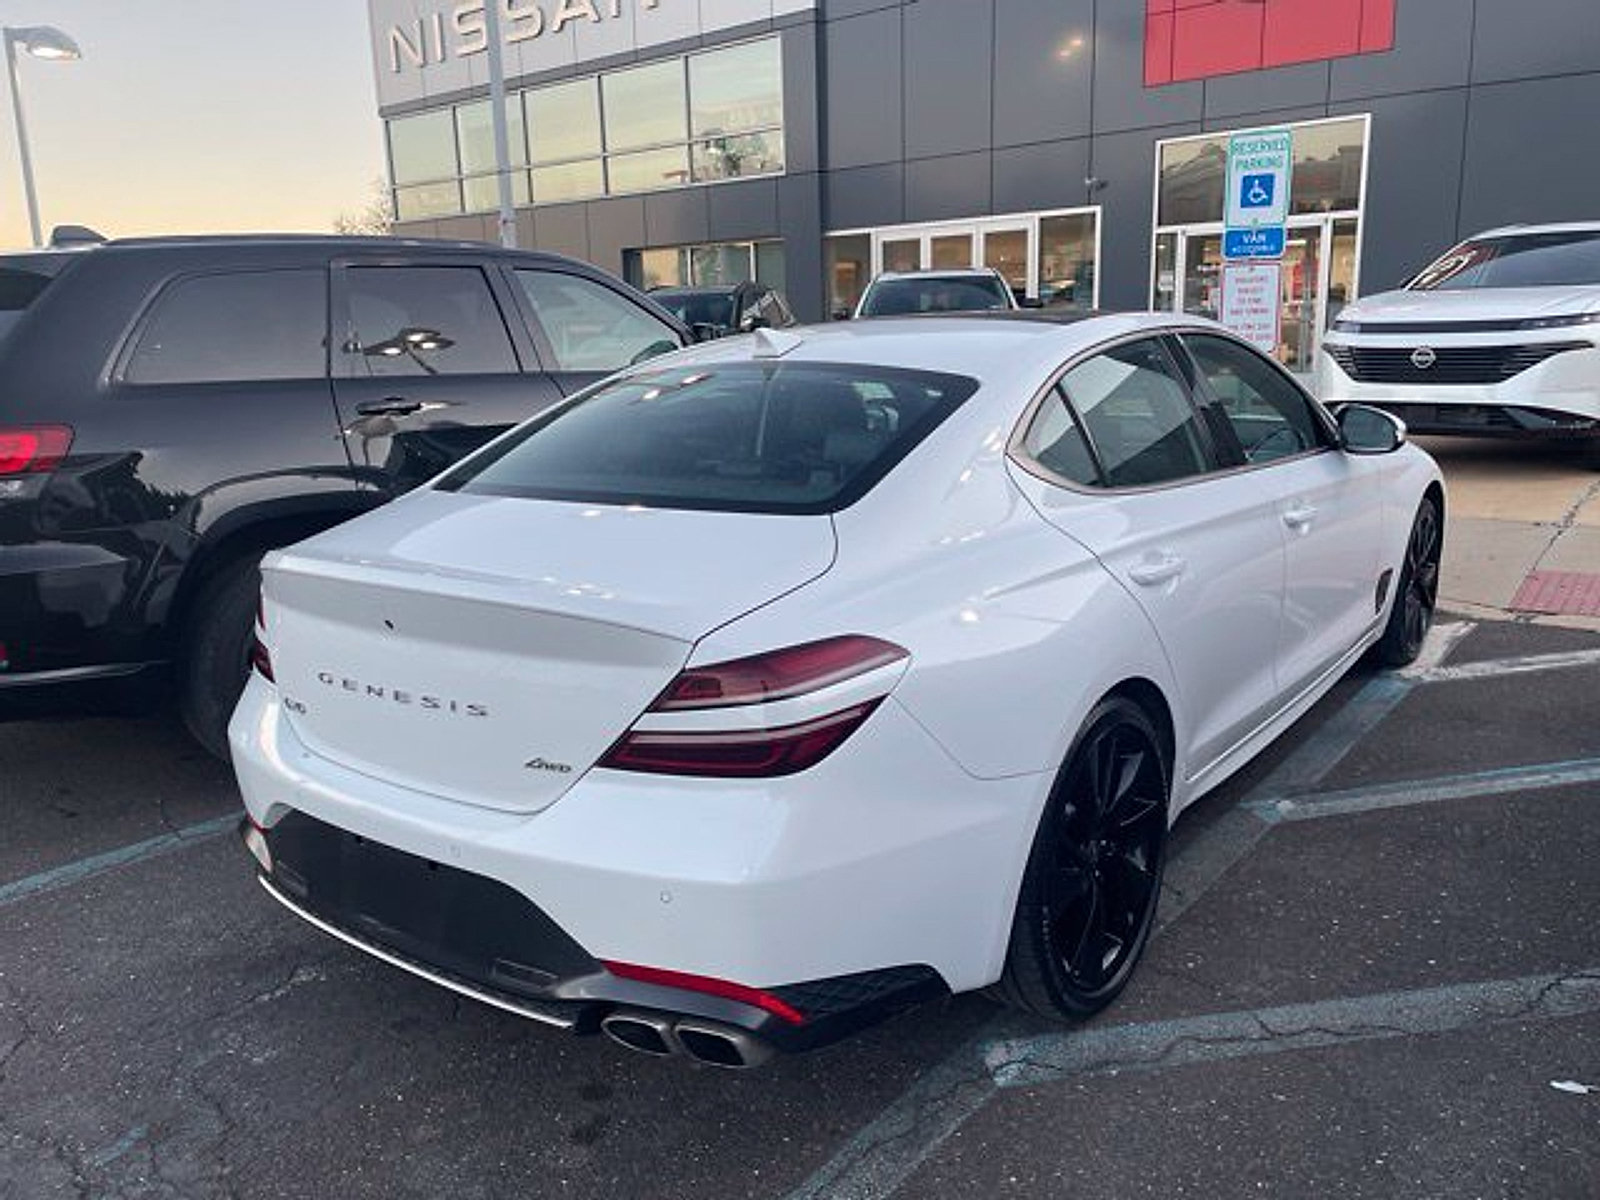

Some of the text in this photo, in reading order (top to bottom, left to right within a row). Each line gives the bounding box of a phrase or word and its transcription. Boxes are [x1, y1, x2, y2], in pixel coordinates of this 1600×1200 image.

[1232, 137, 1286, 154] RESERVED
[1235, 155, 1283, 171] PARKING
[1242, 232, 1266, 244] VAN
[318, 672, 488, 716] GENESIS
